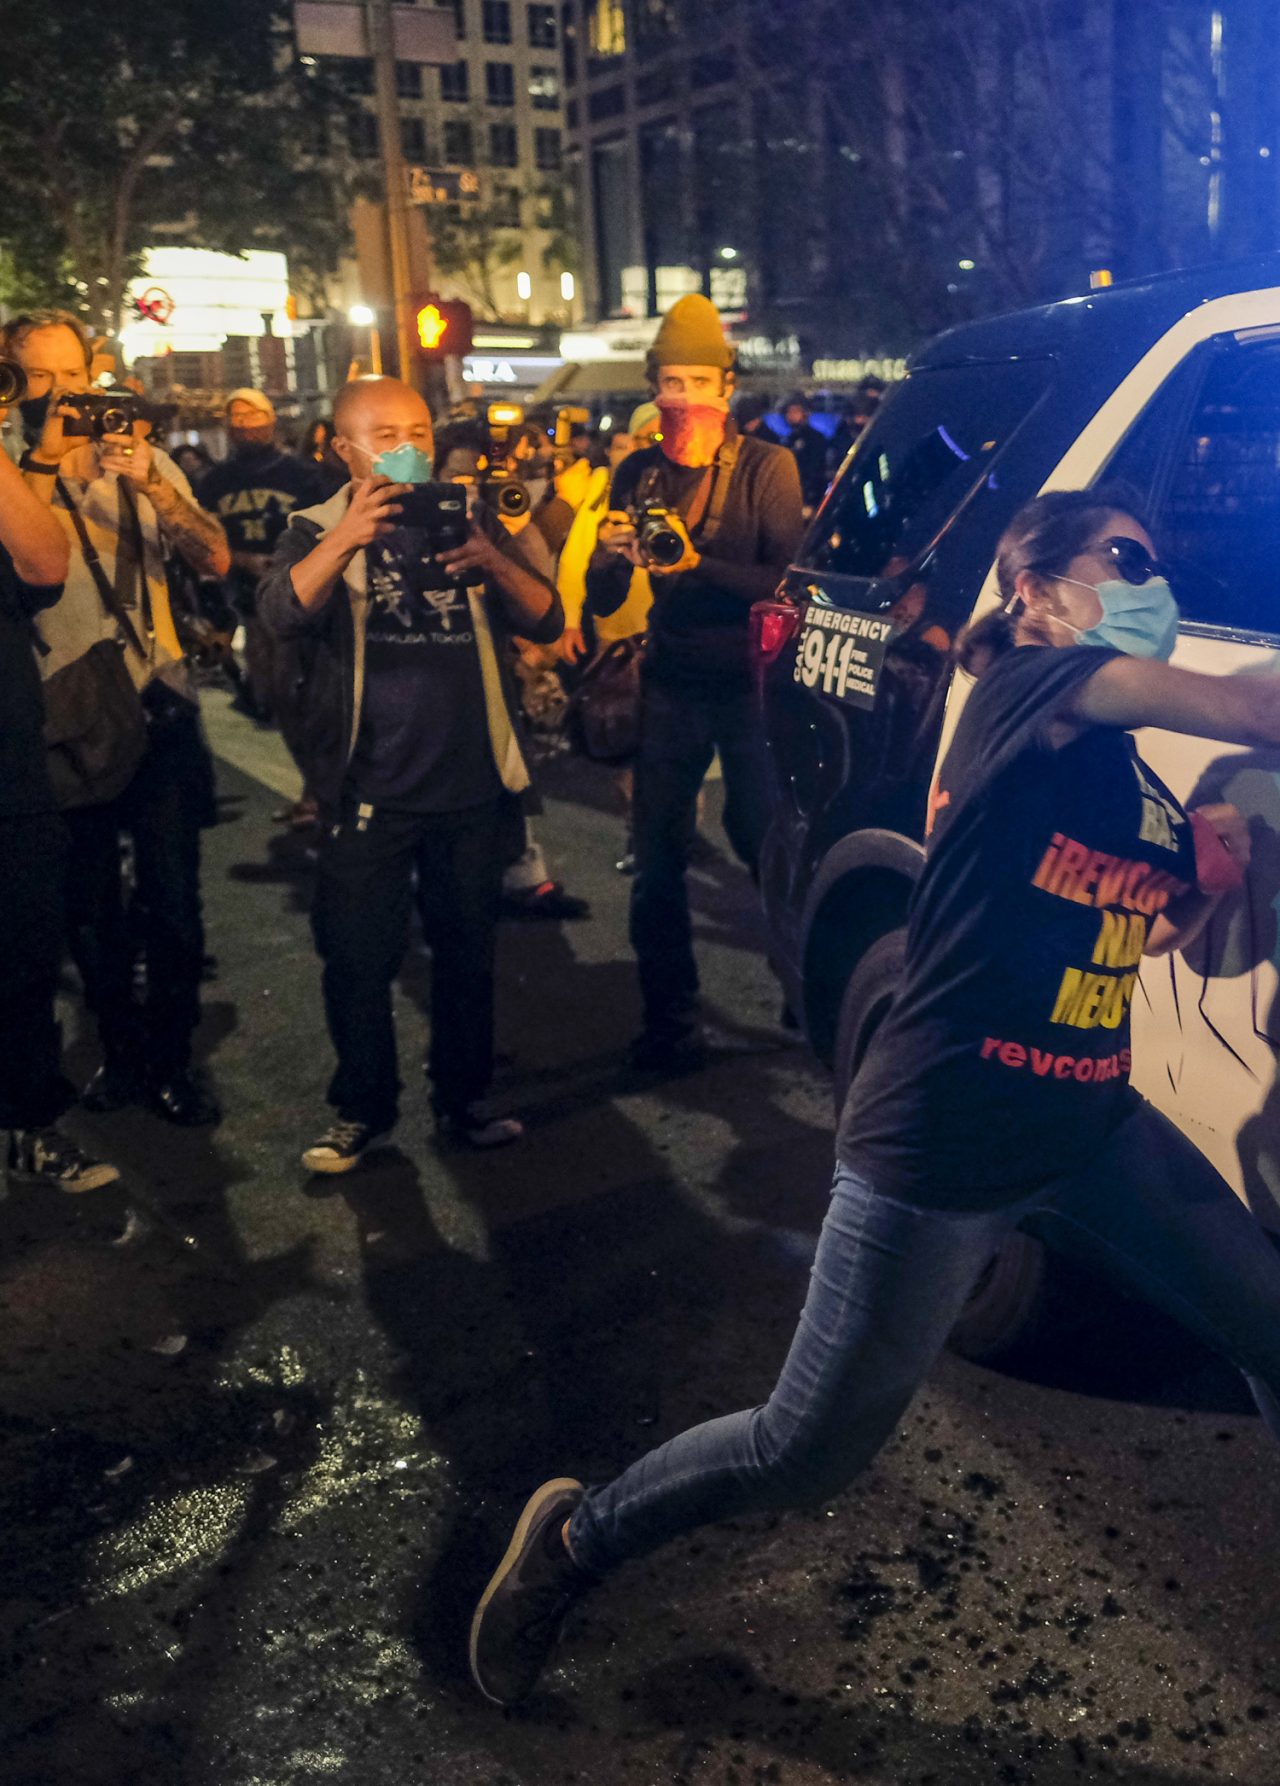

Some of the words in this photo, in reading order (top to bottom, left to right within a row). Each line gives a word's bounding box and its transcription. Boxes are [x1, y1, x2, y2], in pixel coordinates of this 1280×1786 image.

[804, 606, 892, 642] EMERGENCY
[847, 663, 874, 681] POLICE
[845, 677, 876, 697] MEDICAL
